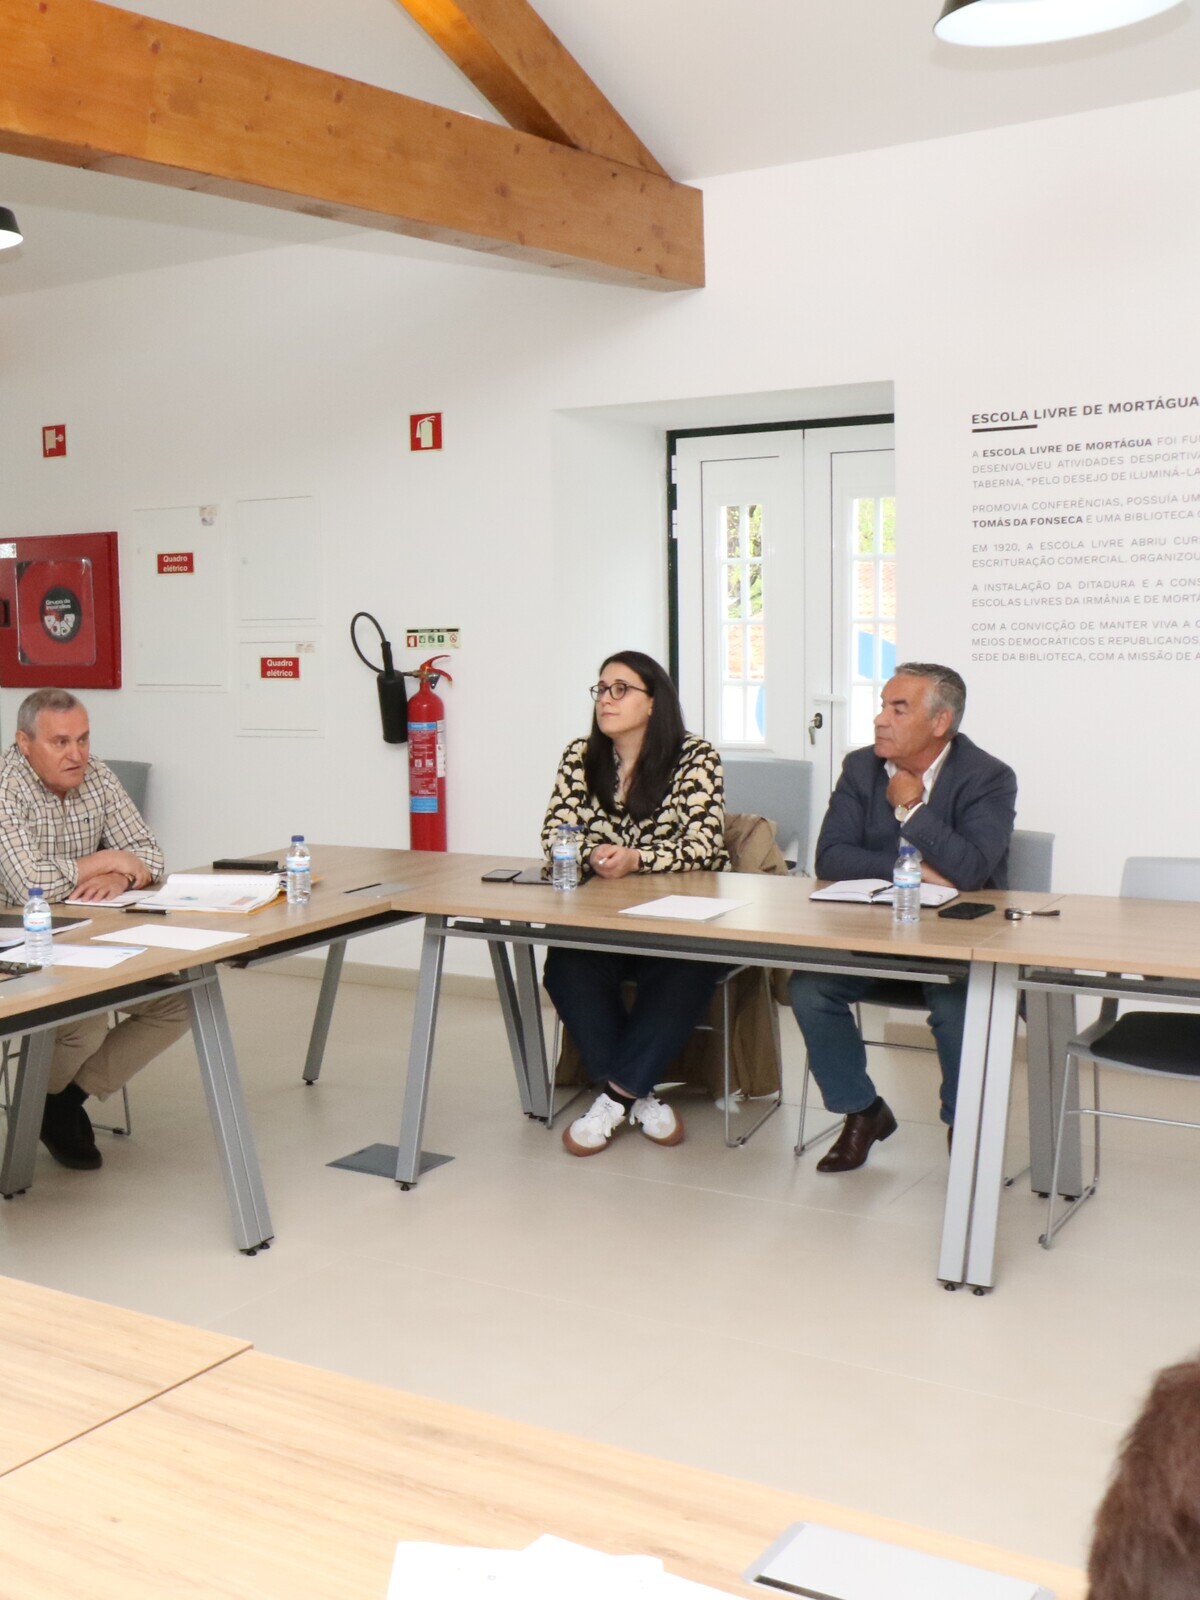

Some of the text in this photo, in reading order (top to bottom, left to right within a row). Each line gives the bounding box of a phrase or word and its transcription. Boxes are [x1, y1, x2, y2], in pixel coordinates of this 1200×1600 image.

[971, 396, 1200, 424] ESCOLA LIVRE DE MORTÁGUA
[972, 434, 1200, 458] A ESCOLA LIVRE DE MORTÁGUA FOI FU
[972, 461, 1051, 474] DESENVOLVEU
[1057, 456, 1124, 468] ATIVIDADES
[1063, 472, 1108, 484] DESEJO
[1111, 471, 1127, 481] DE
[972, 503, 1029, 513] PROMOVIA
[1126, 493, 1178, 506] POSSUÍA
[972, 516, 1011, 528] TOMÁS
[1014, 517, 1028, 527] DA
[1030, 515, 1083, 526] FONSECA
[1086, 515, 1092, 524] E
[1095, 514, 1122, 523] UMA
[1124, 510, 1194, 522] BIBLIOTECA
[972, 536, 1200, 553] EM 1920, A ESCOLA LIVRE ABRIU CUR
[163, 555, 188, 563] Quadro
[971, 584, 979, 592] A
[984, 580, 1051, 593] INSTALAÇÃO
[1057, 581, 1072, 590] DA
[1078, 579, 1135, 590] DITADURA
[1142, 579, 1149, 587] E
[1156, 579, 1163, 587] A
[972, 598, 1021, 607] ESCOLAS
[1023, 597, 1062, 606] LIVRES
[1065, 596, 1080, 605] DA
[1134, 596, 1141, 604] E
[1143, 595, 1159, 604] DE
[971, 623, 996, 632] COM
[999, 622, 1007, 631] A
[1080, 621, 1095, 630] DE
[1099, 620, 1147, 630] MANTER
[1152, 620, 1179, 629] VIVA
[1183, 620, 1191, 629] A
[971, 637, 1006, 646] MEIOS
[1099, 637, 1105, 645] E
[971, 653, 999, 662] SEDE
[1002, 653, 1016, 661] DA
[1019, 652, 1086, 662] BIBLIOTECA,
[1088, 652, 1115, 662] COM
[1117, 652, 1125, 661] A
[1127, 650, 1173, 661] MISSÃO
[1176, 652, 1191, 661] DE
[266, 659, 293, 667] Quadro
[266, 669, 293, 677] elétrico
